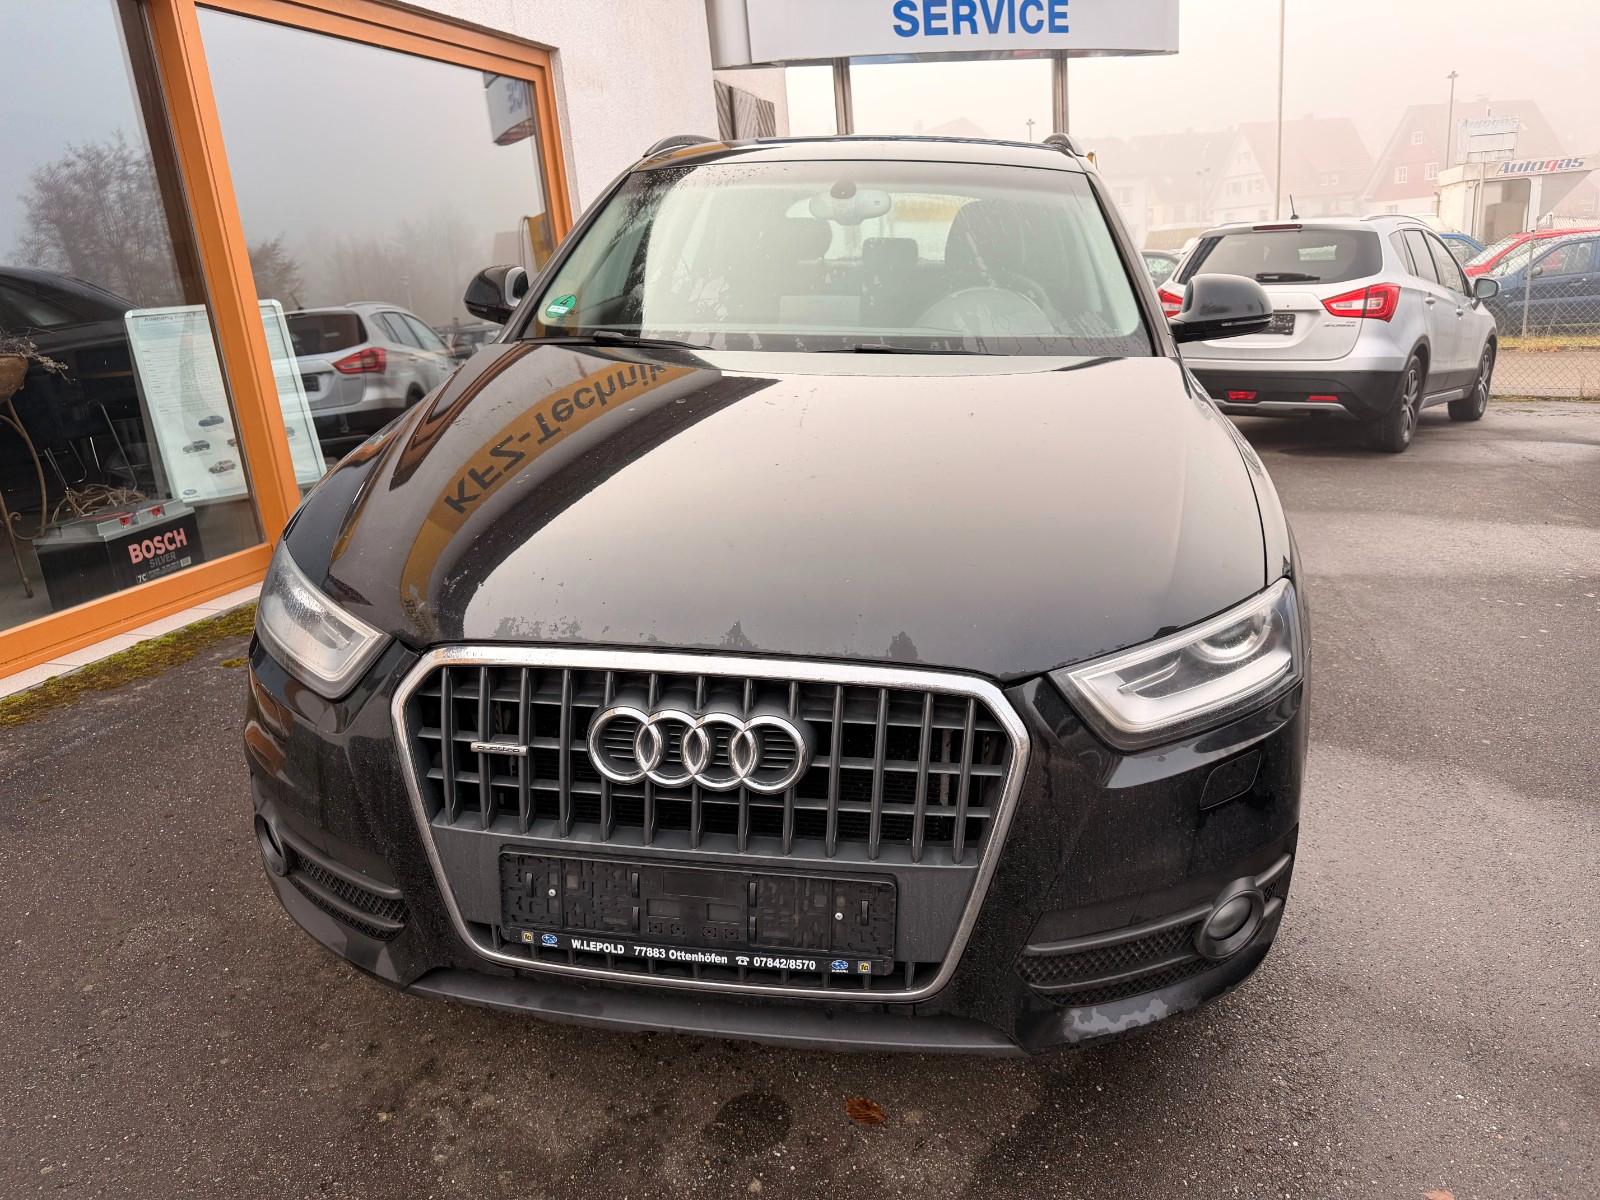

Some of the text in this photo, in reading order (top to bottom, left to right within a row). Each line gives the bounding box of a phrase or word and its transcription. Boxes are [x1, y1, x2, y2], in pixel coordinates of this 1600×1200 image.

[893, 0, 1069, 37] SERVICE
[1496, 157, 1586, 174] Autogas
[127, 527, 188, 565] BOSCH
[149, 551, 177, 568] SILVER
[571, 939, 816, 970] W.LEPOLD 77883 Ottenhöfen 07842/8570
